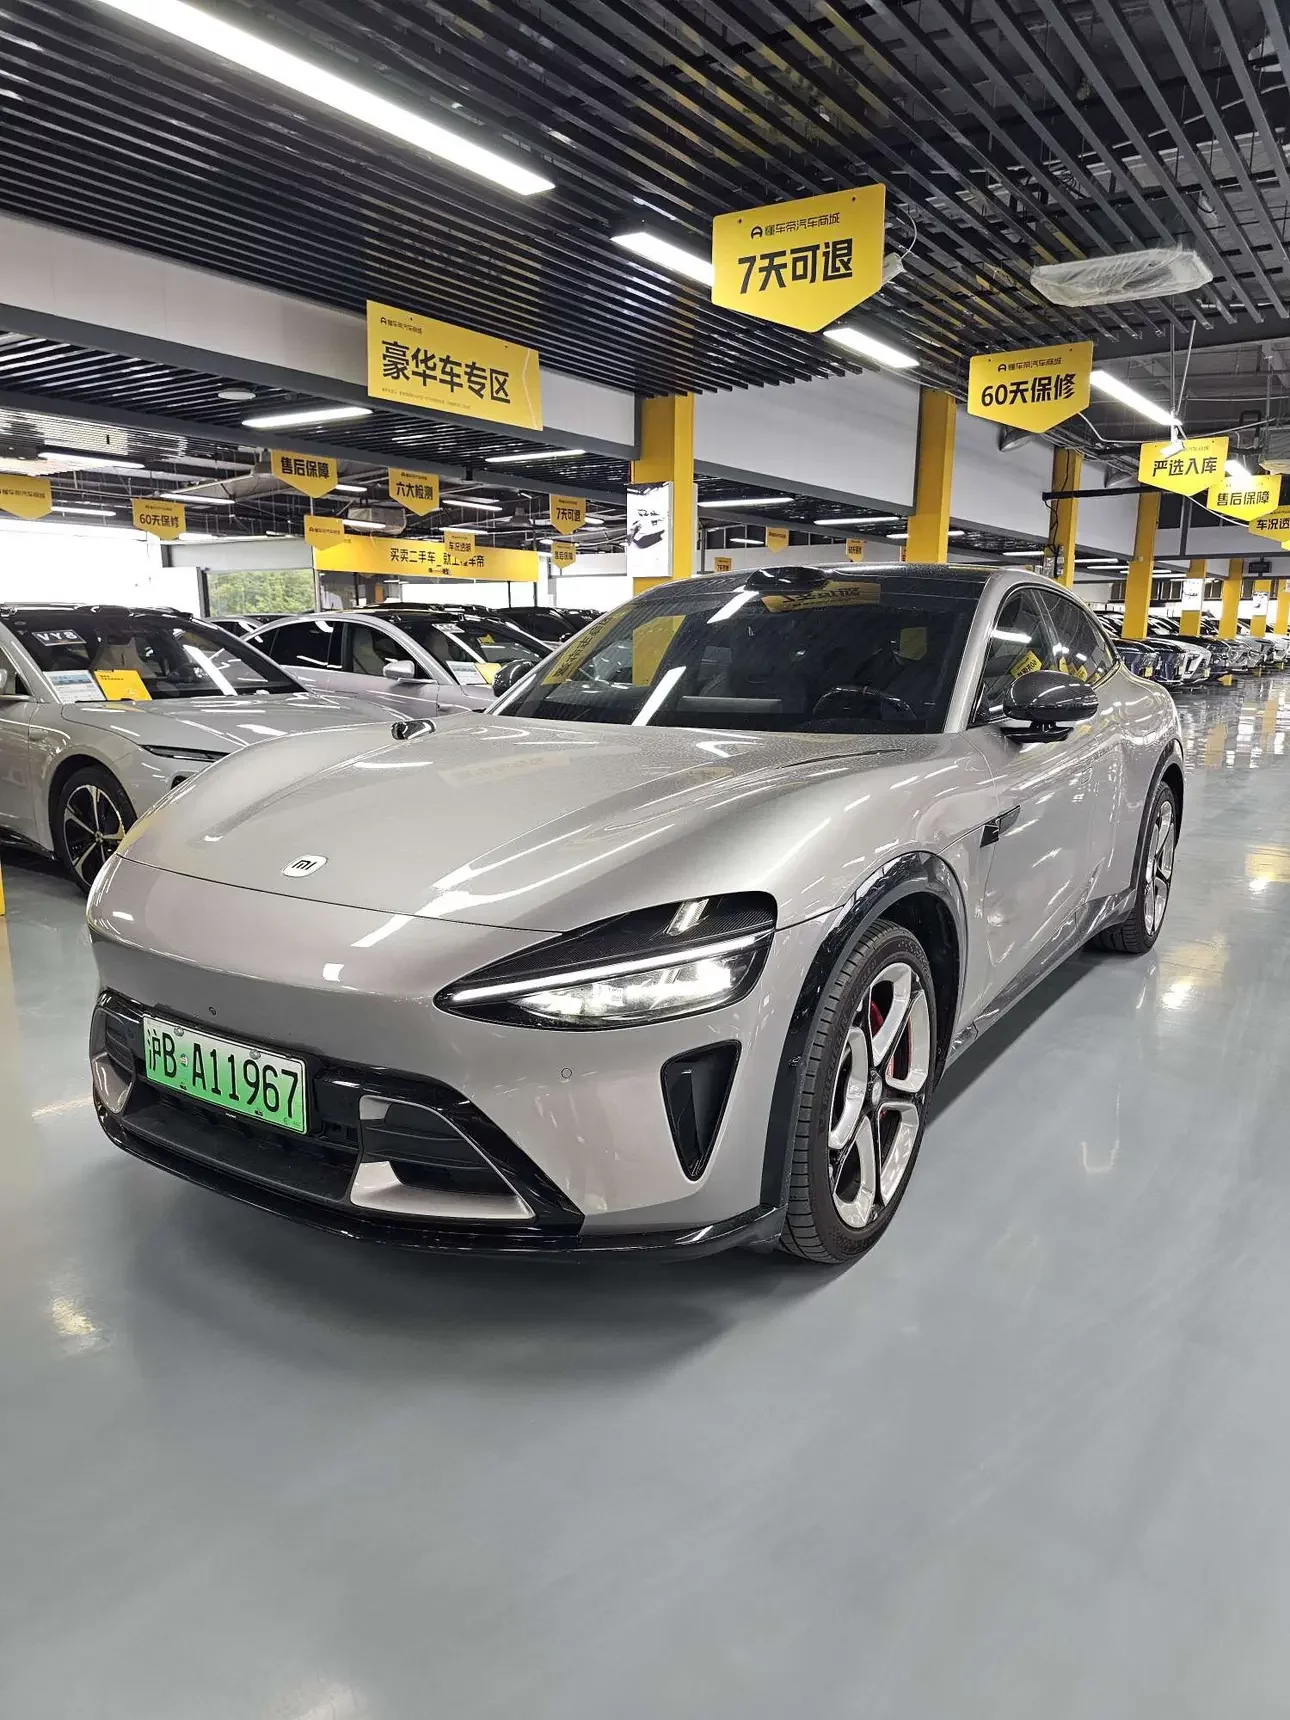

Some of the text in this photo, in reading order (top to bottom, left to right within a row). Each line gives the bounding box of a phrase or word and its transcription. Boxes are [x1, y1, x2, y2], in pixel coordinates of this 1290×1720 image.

[738, 238, 853, 294] 7天可退
[381, 340, 510, 404] 豪华车专区
[981, 373, 1076, 407] 60天保修
[281, 456, 330, 480] 售后保障
[1152, 457, 1218, 477] 严选入库
[396, 482, 433, 501] 六大检测
[1217, 491, 1270, 506] 售后保障
[139, 513, 180, 529] 60天保修
[555, 507, 581, 522] 7天可退
[390, 547, 436, 564] 买卖二手车
